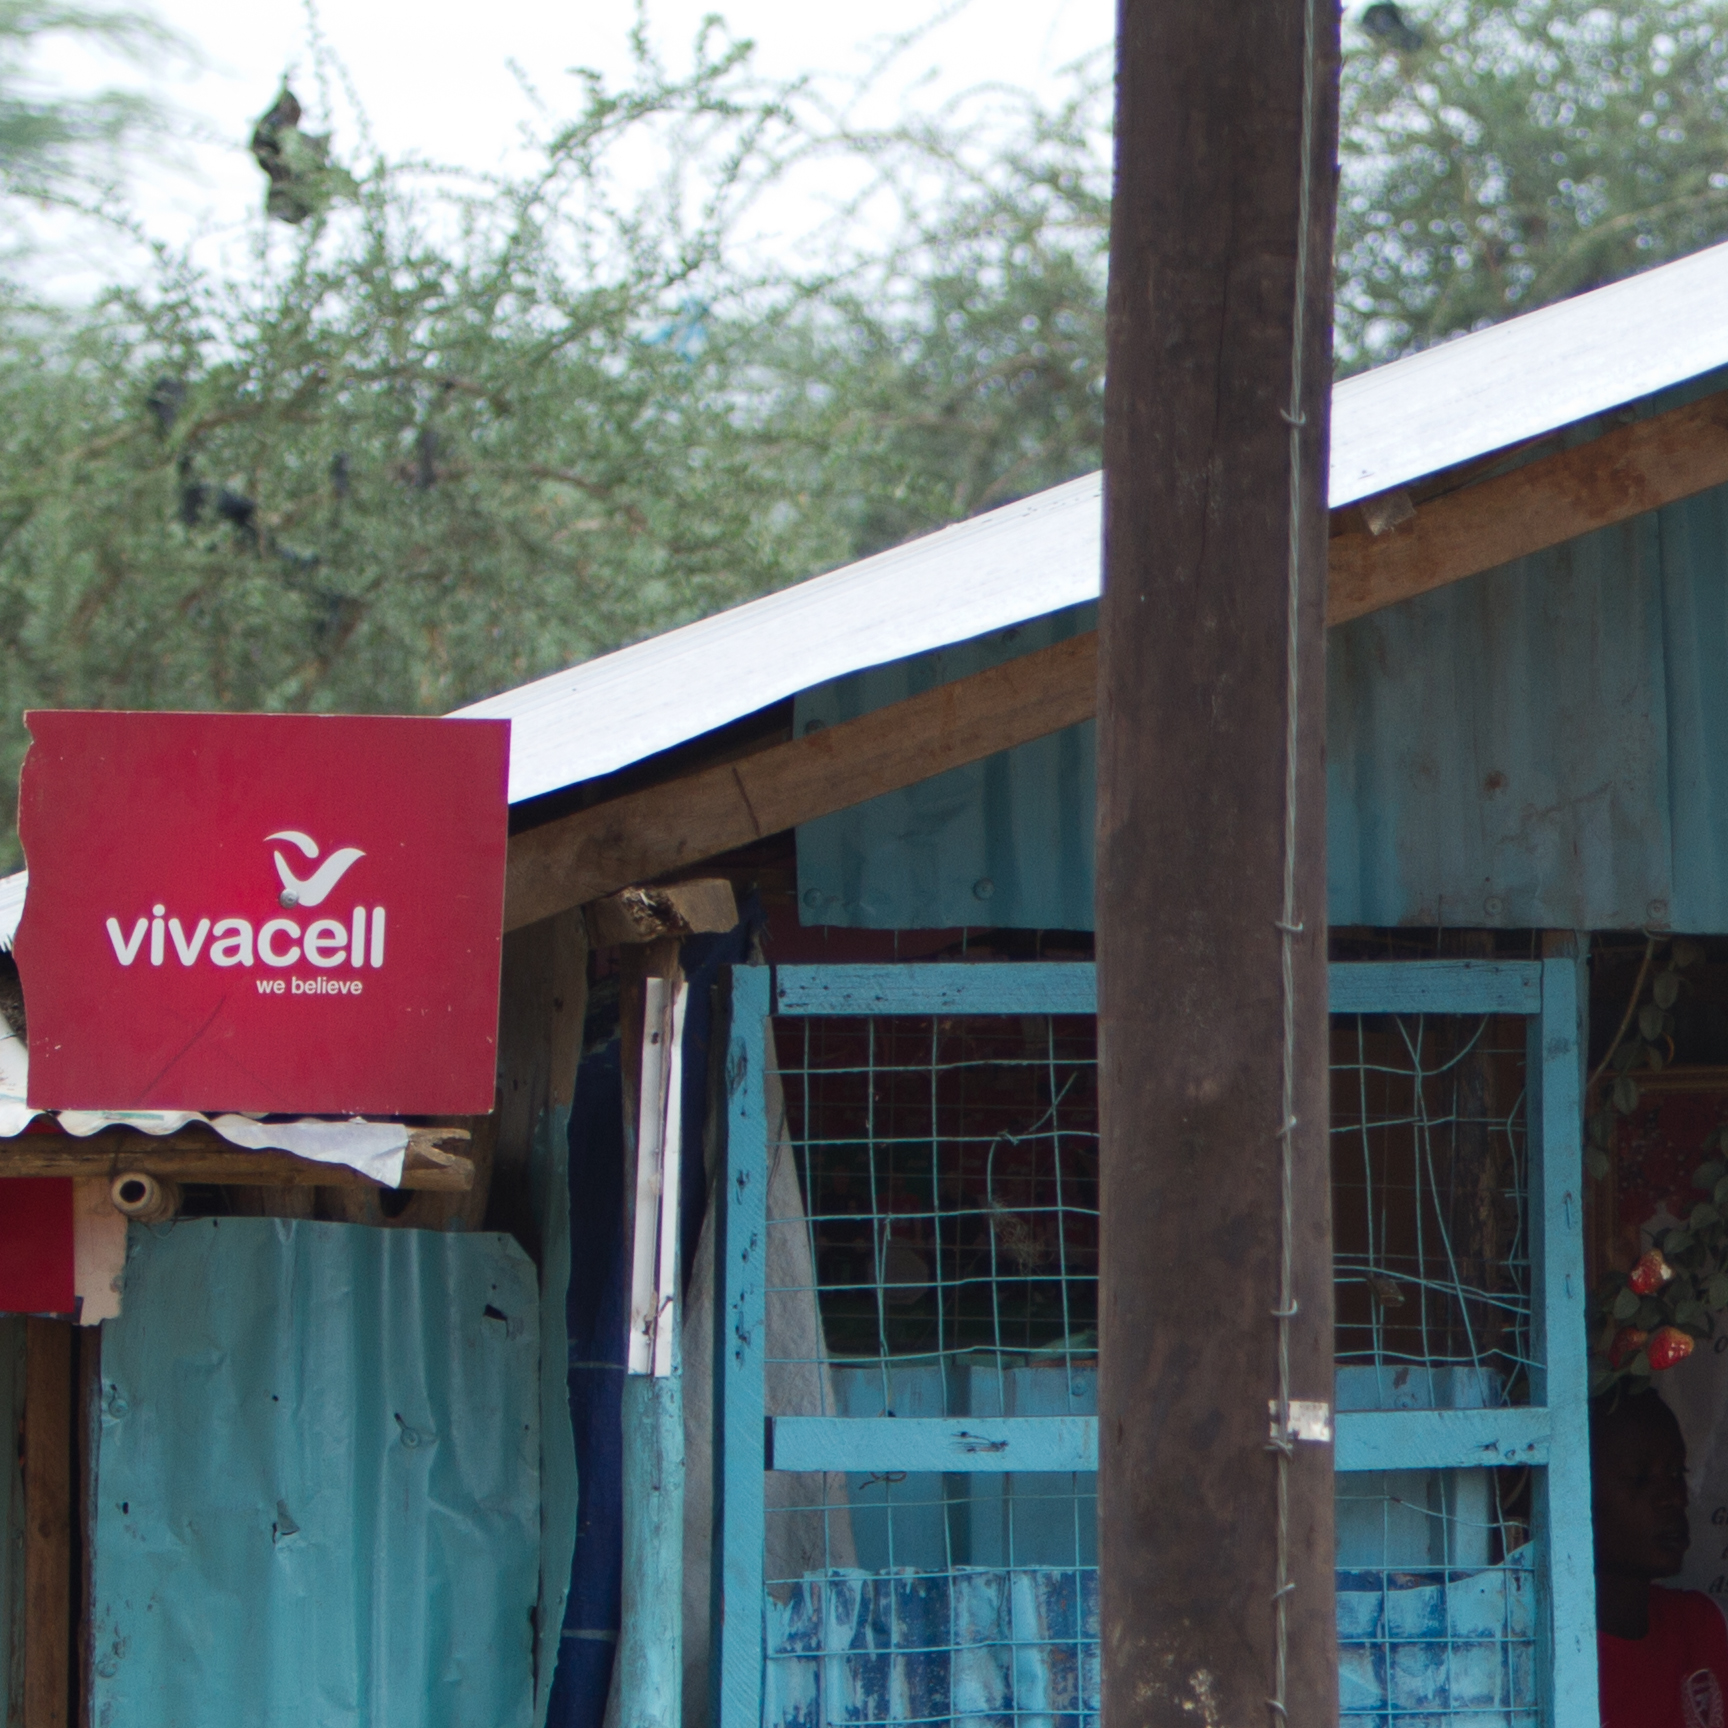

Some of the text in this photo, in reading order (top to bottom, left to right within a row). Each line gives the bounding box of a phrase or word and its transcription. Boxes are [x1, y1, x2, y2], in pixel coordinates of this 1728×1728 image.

[105, 903, 387, 969] vivacell
[256, 976, 363, 995] we believe
